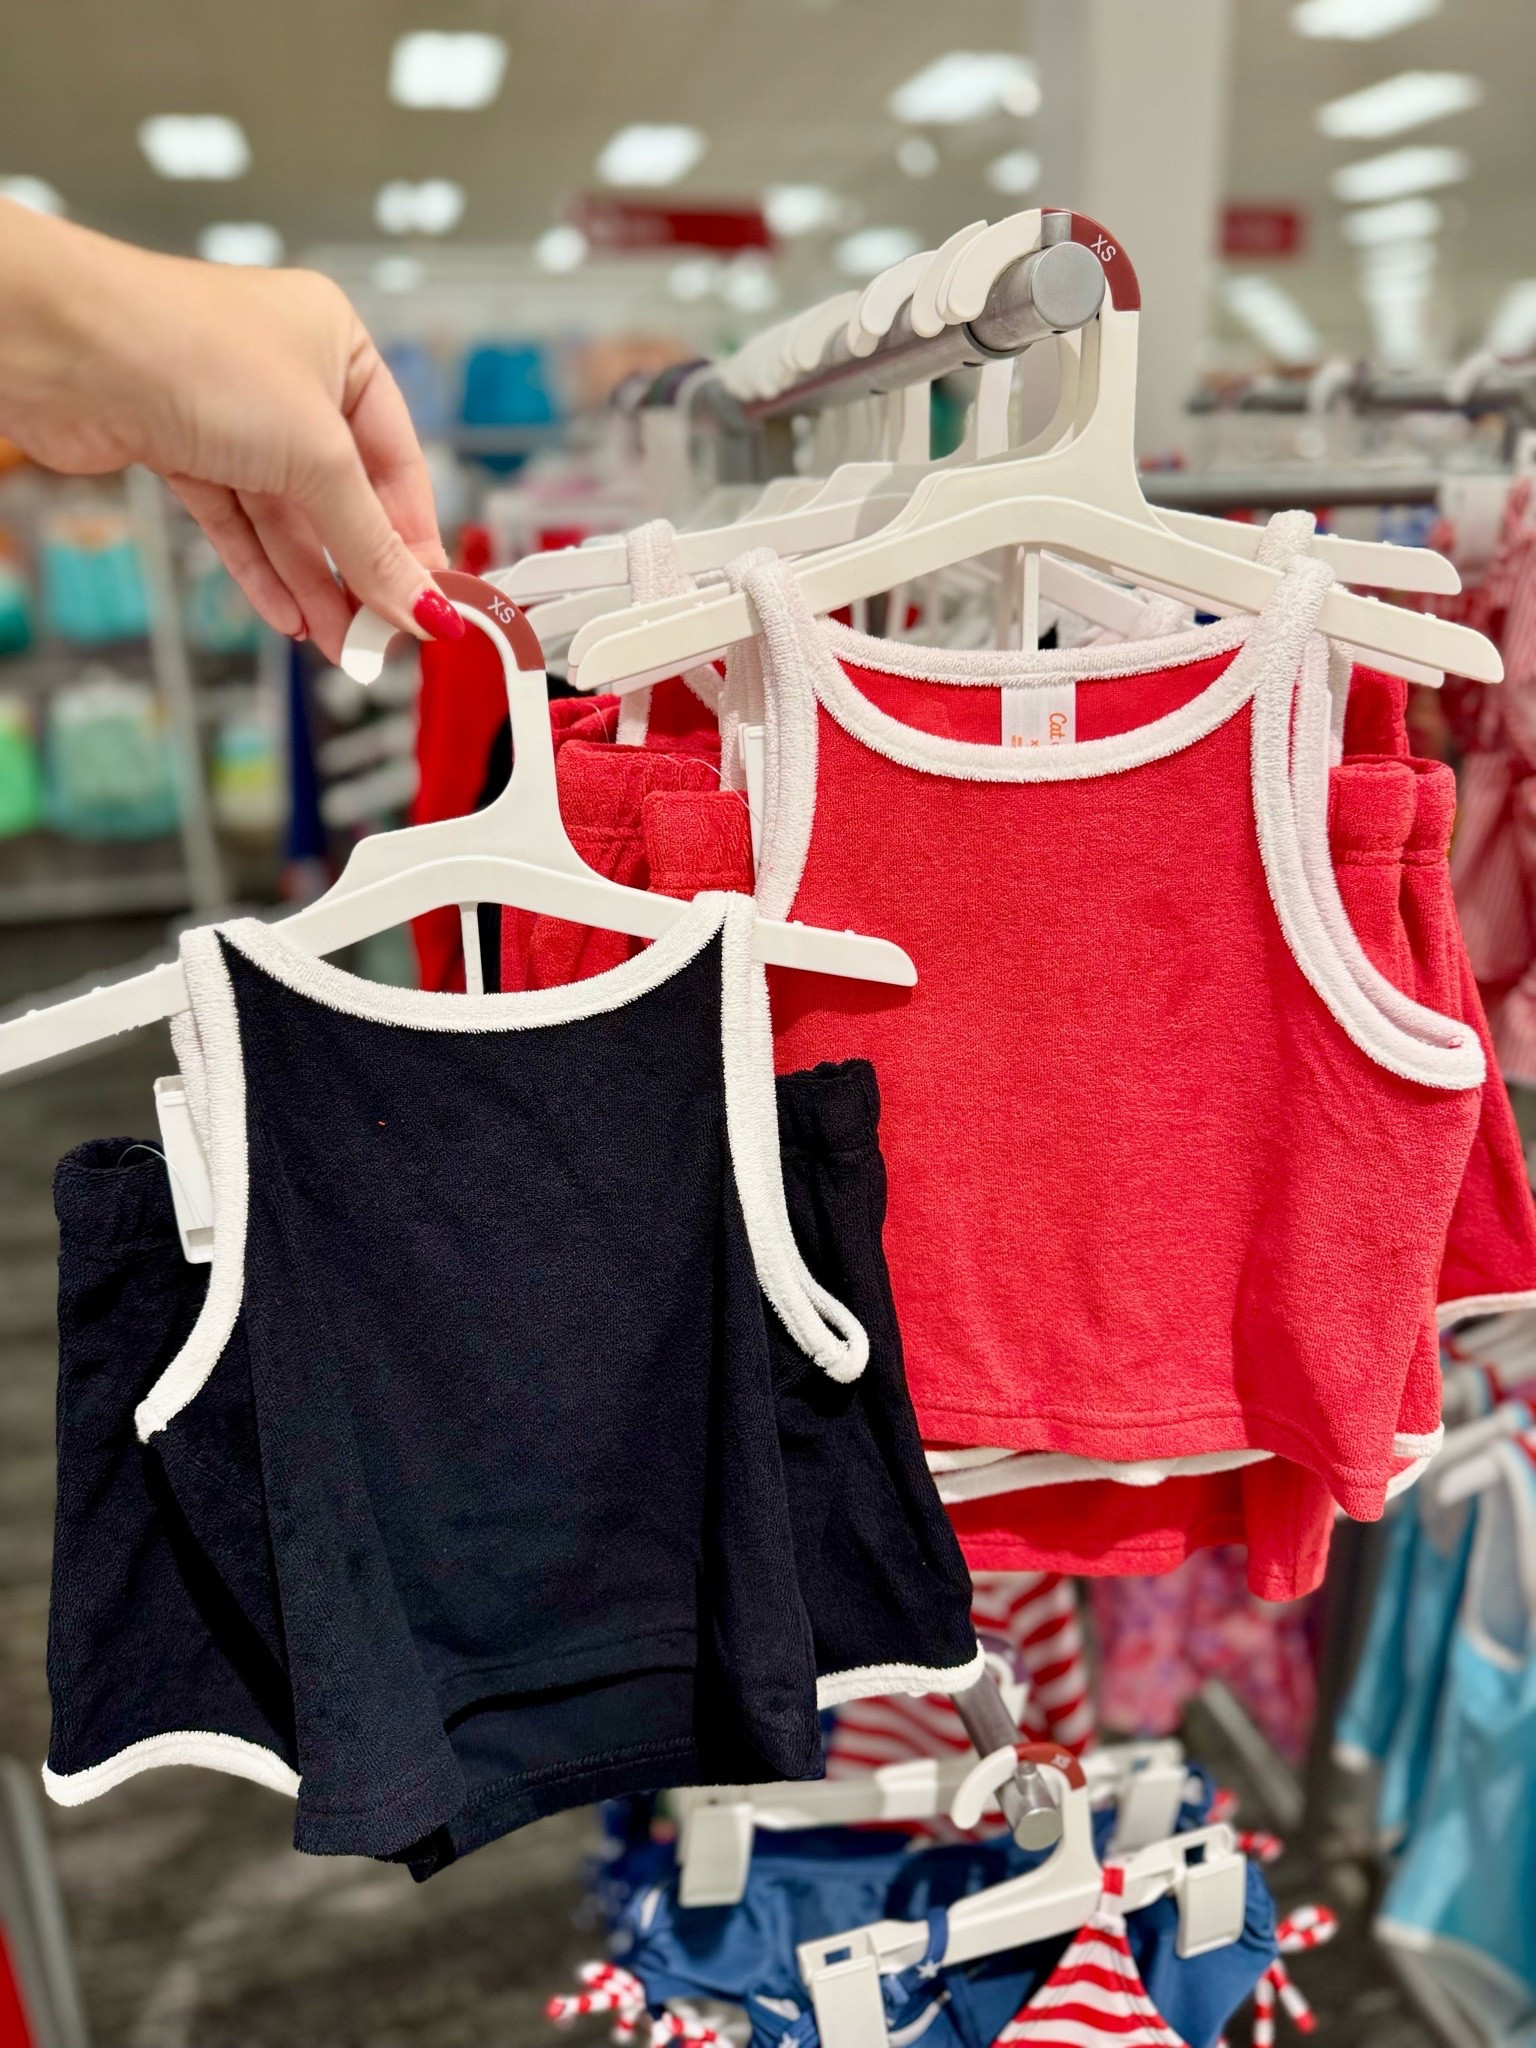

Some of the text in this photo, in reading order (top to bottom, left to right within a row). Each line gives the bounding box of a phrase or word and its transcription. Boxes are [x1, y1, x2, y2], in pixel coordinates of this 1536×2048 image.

[1090, 233, 1117, 262] XS
[487, 595, 515, 624] XS
[1049, 712, 1067, 740] Cat
